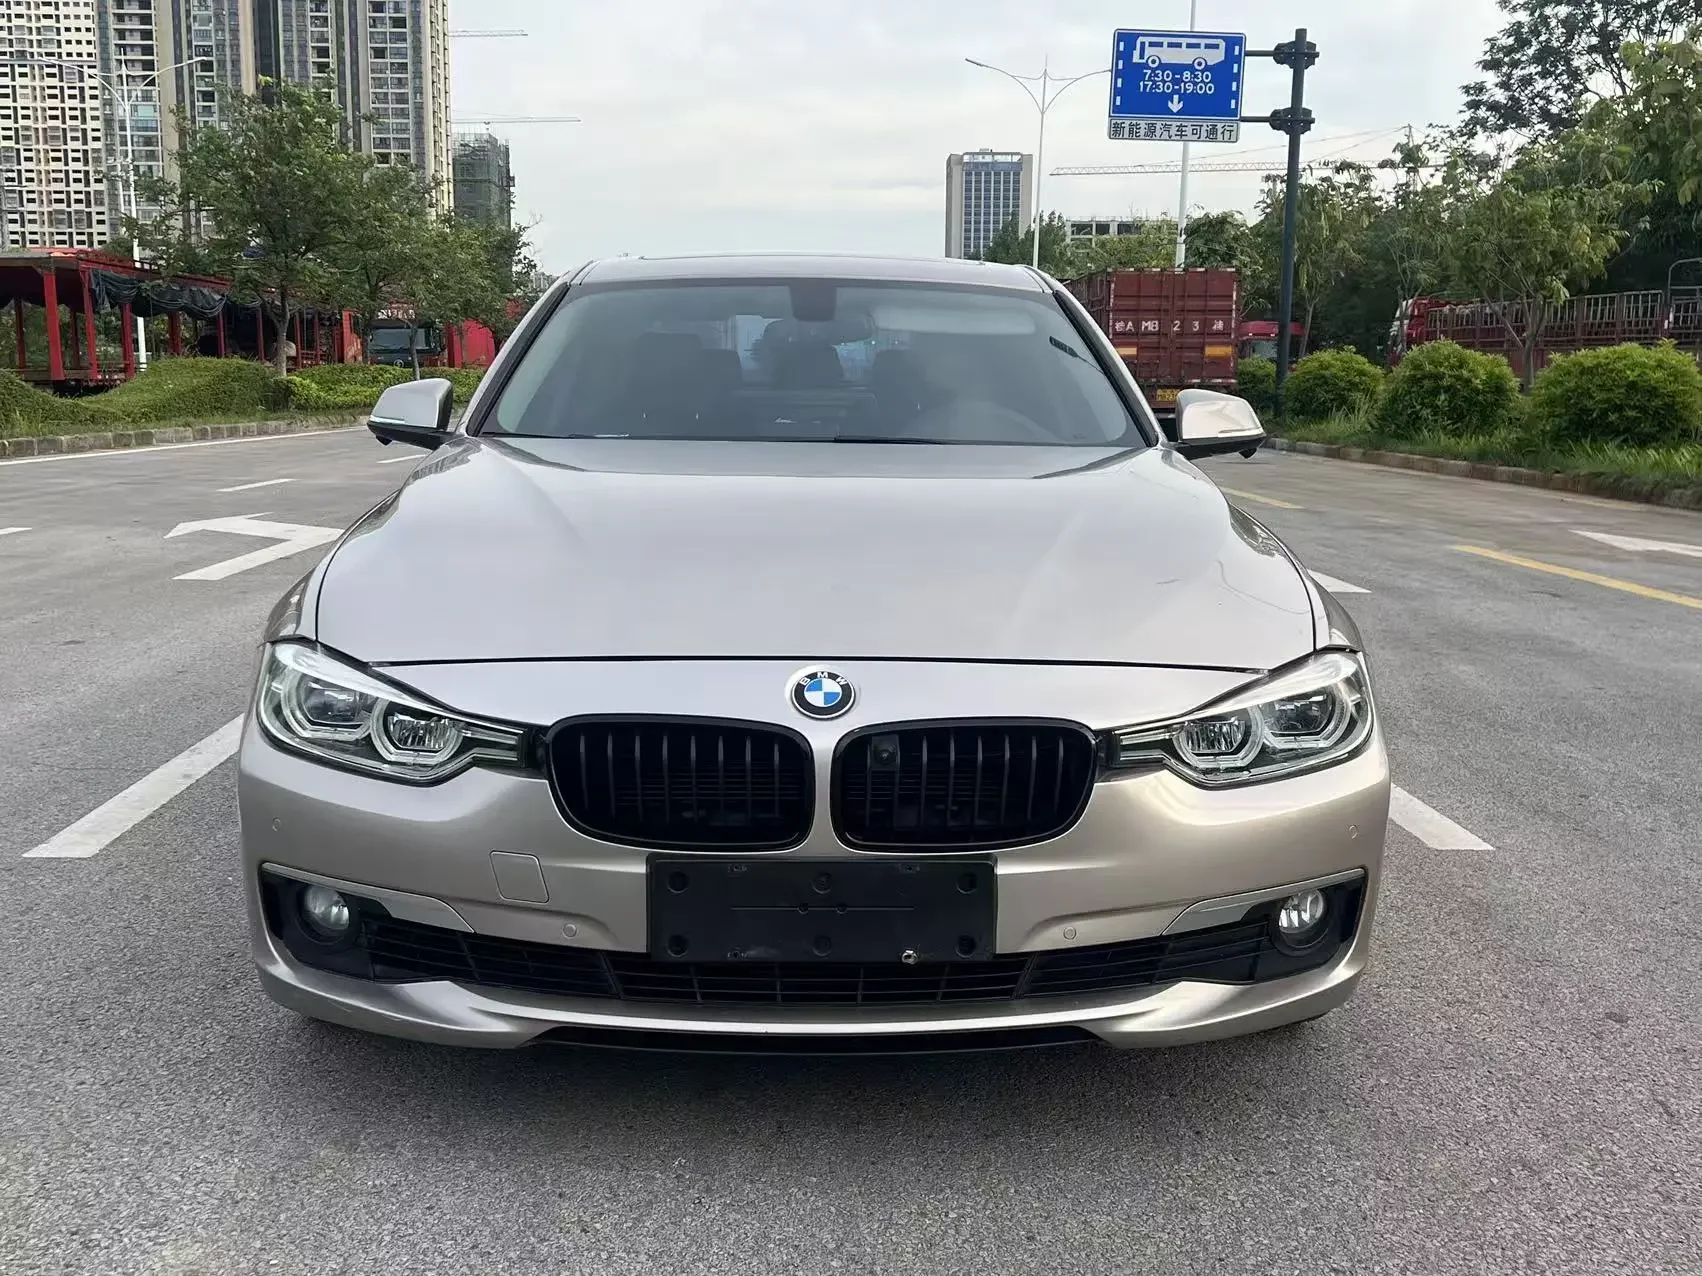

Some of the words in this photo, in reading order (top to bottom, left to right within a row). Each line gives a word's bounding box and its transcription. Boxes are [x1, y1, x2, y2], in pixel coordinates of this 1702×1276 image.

[1139, 81, 1215, 94] 17:30-19:00
[1111, 121, 1234, 140] 新能源汽车可通行
[799, 671, 848, 686] BMW
